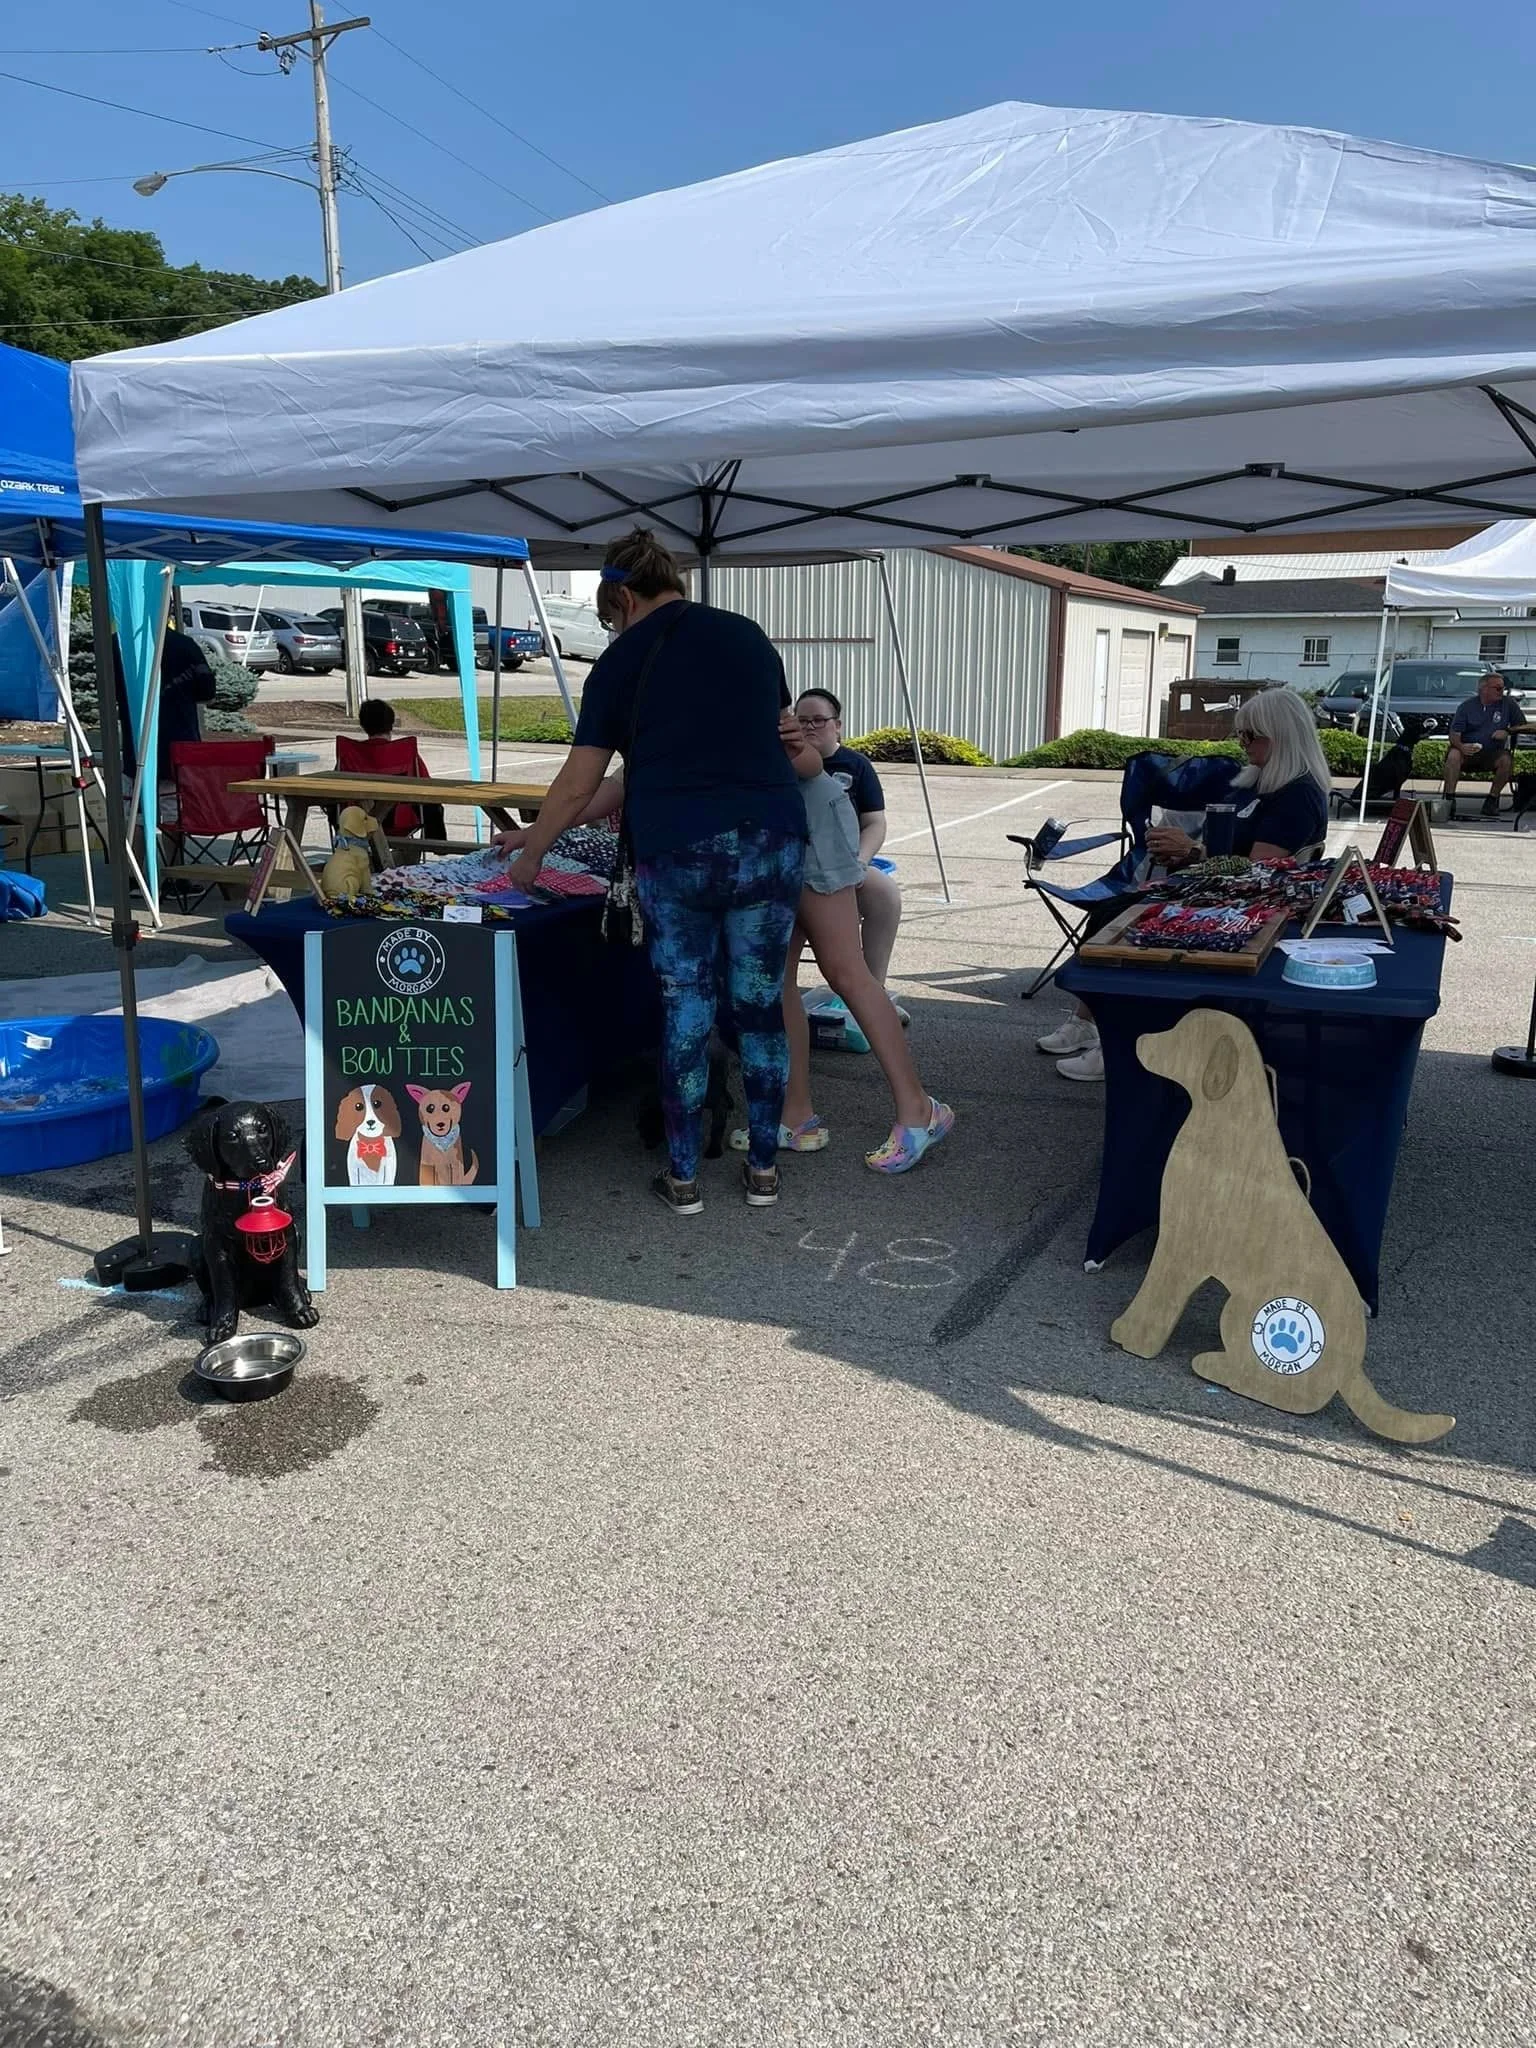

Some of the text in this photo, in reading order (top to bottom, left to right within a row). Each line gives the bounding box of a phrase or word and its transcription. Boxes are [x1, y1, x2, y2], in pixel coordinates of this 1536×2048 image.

[382, 930, 432, 952] MADE BY
[388, 978, 433, 993] MORGAN
[336, 996, 475, 1026] BANDANAS
[399, 1023, 412, 1044] &
[341, 1046, 465, 1077] BOW TIES
[798, 1229, 961, 1289] 48
[1263, 1299, 1309, 1317] MADE BY
[1259, 1350, 1303, 1374] MORGAN
